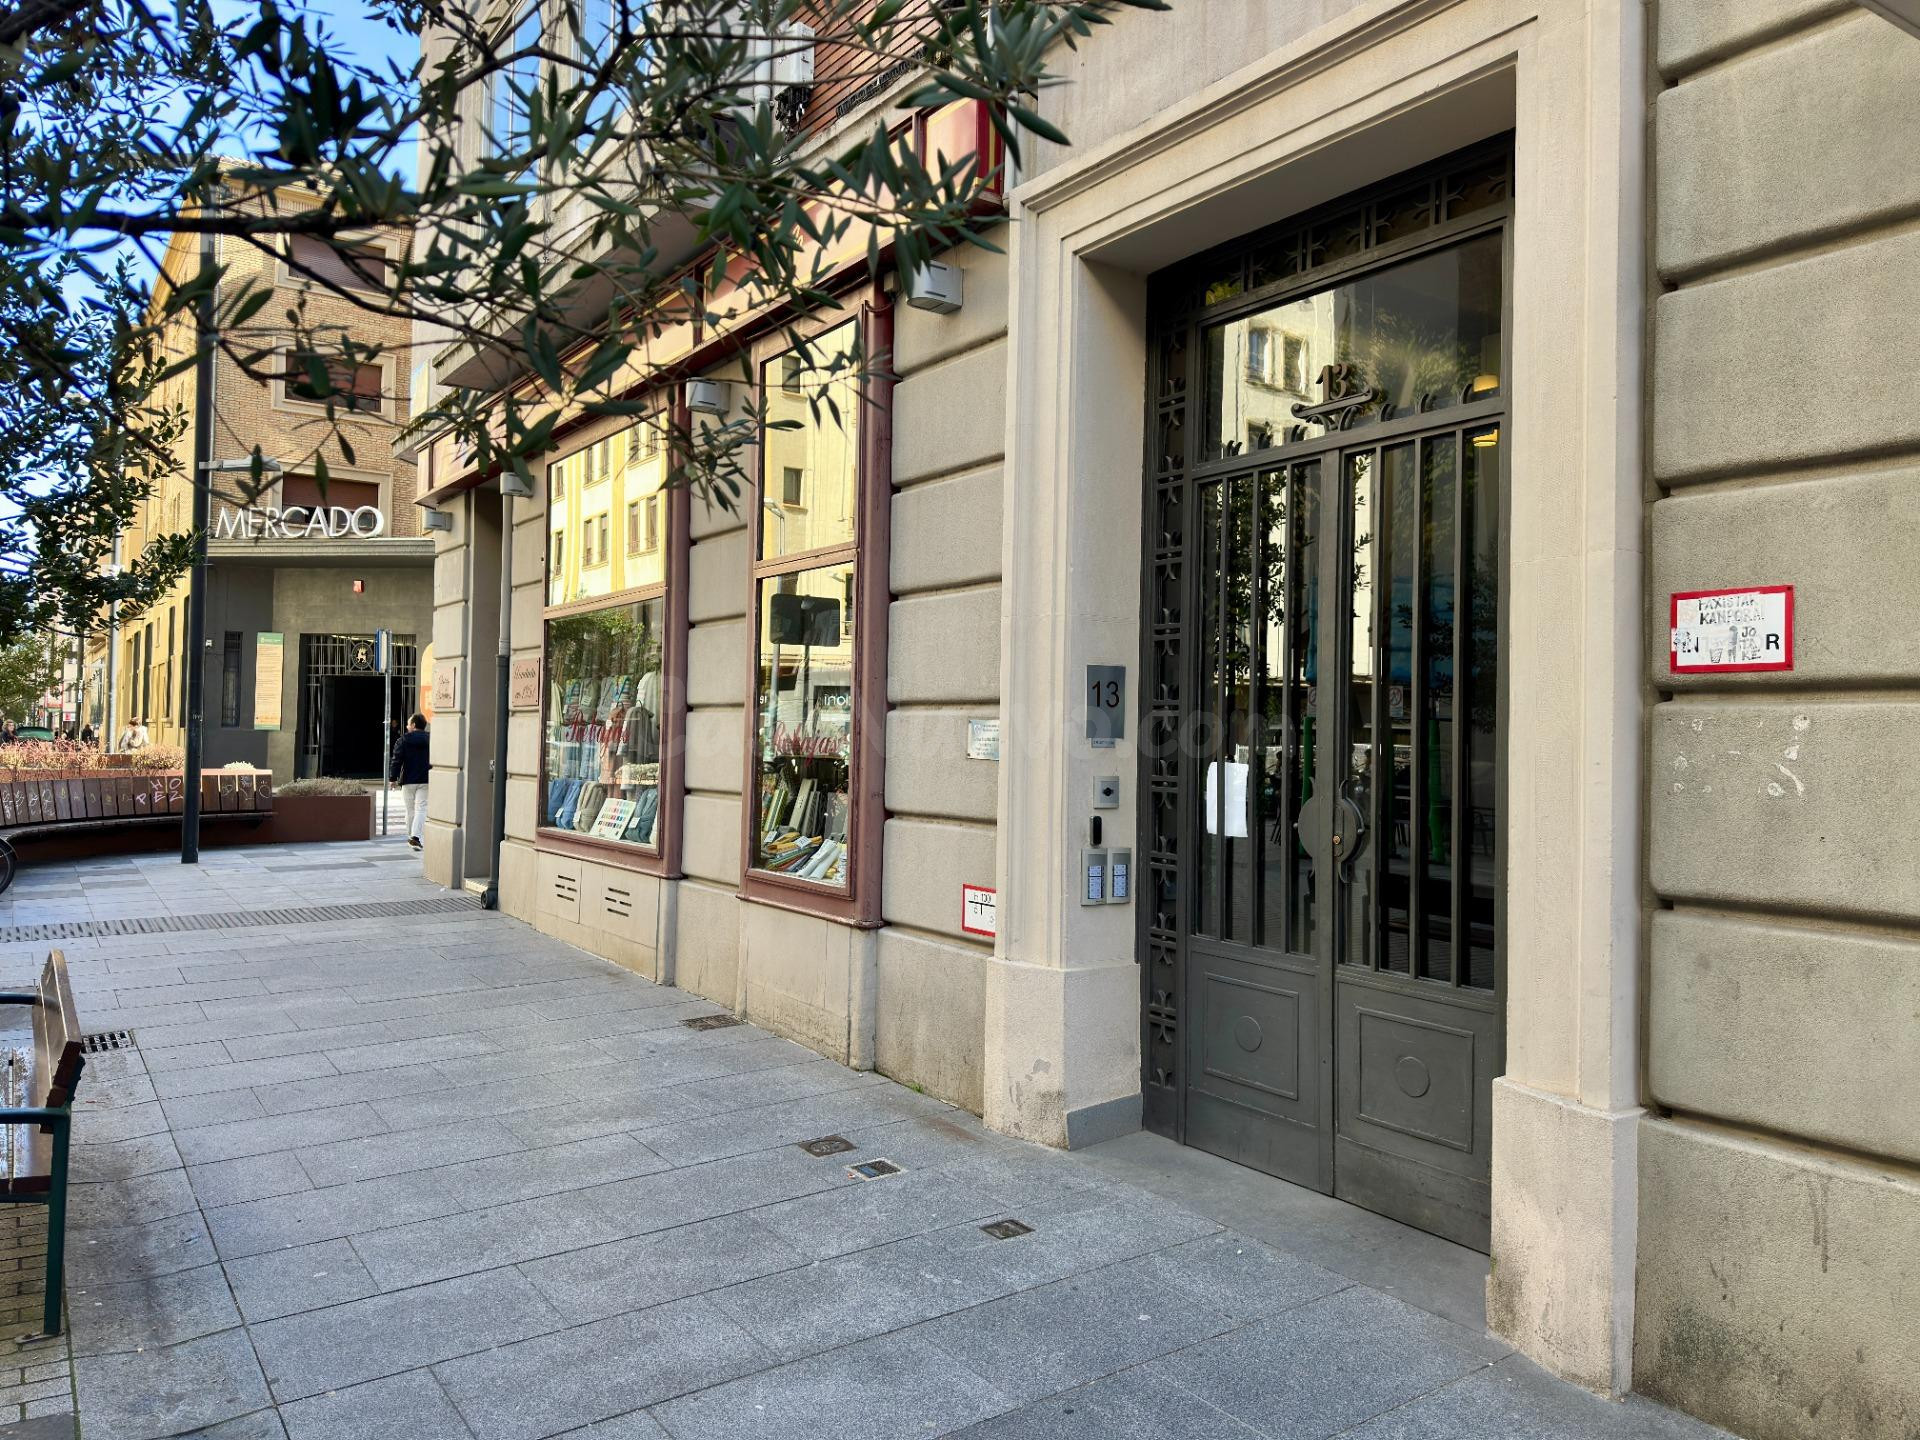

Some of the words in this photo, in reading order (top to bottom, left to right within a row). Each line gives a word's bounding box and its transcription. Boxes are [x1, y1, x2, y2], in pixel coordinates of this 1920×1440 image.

[1316, 364, 1350, 403] 13
[214, 505, 386, 539] MERCADO
[1765, 633, 1780, 651] R
[1092, 680, 1120, 708] 13
